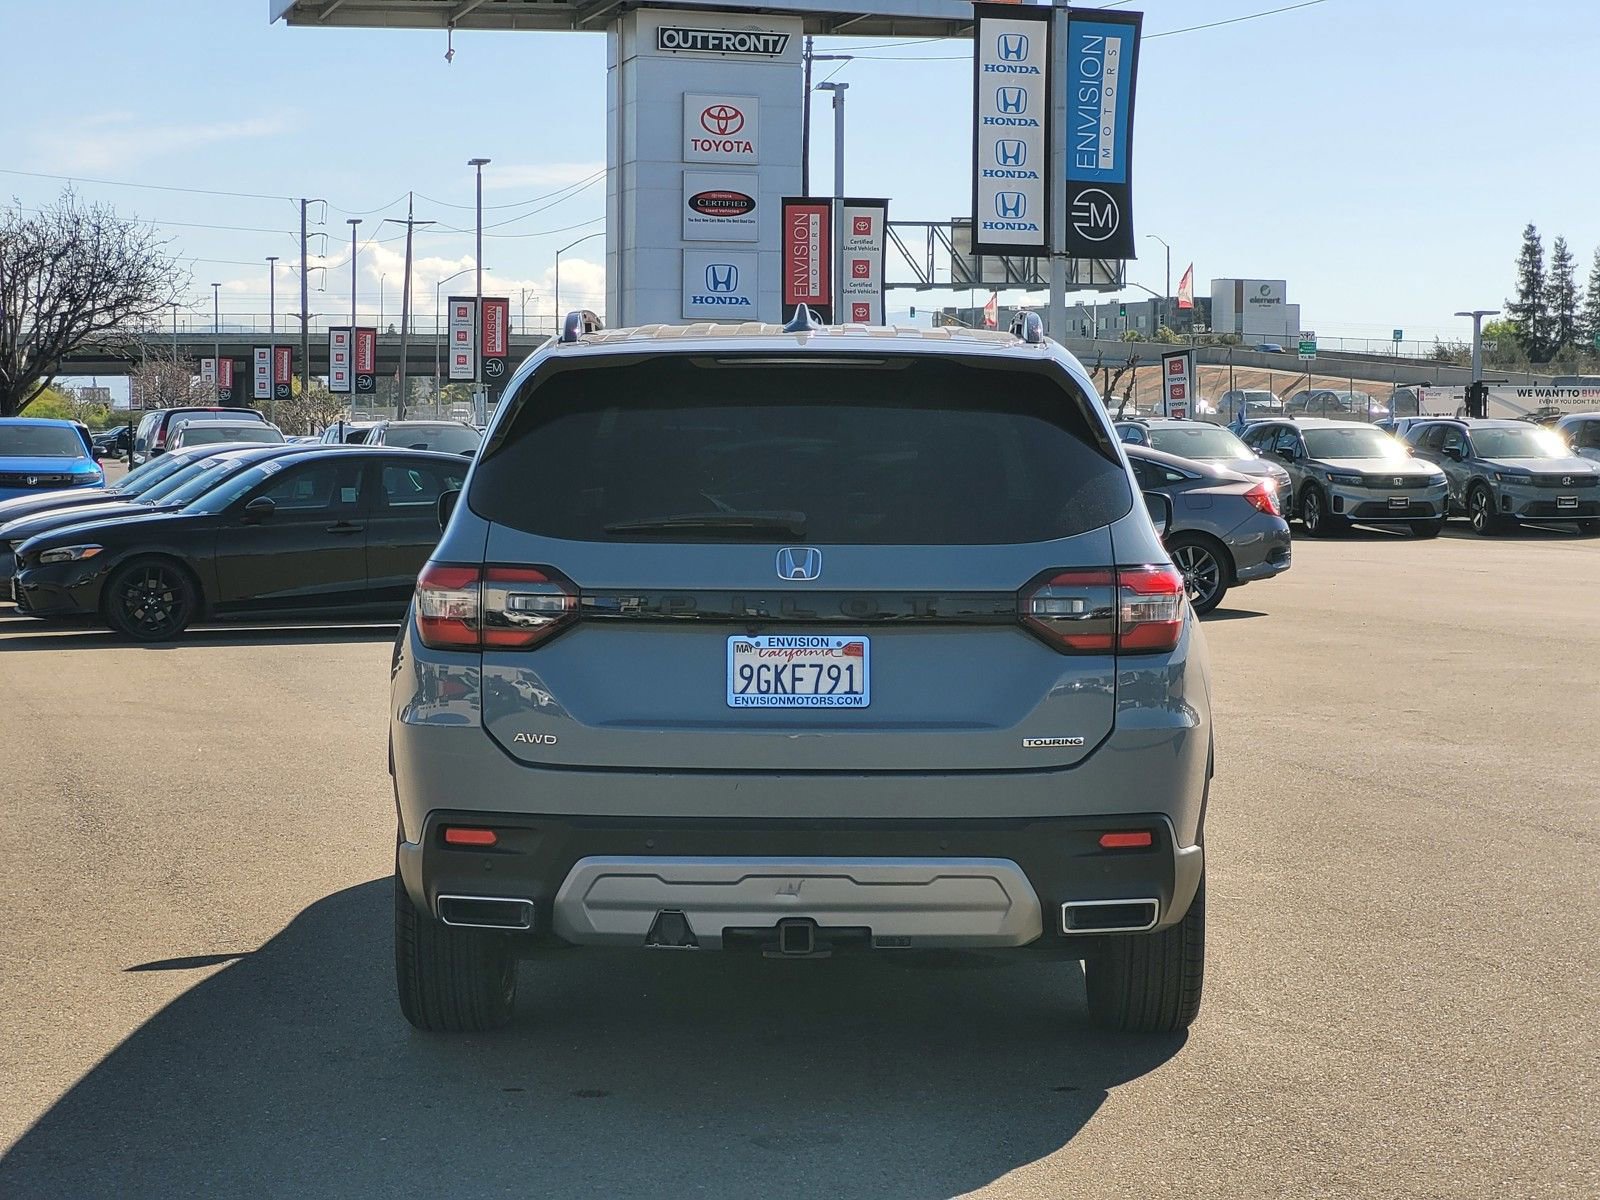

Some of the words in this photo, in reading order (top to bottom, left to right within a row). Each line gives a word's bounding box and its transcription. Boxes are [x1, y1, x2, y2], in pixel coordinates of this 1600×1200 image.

[983, 64, 1041, 75] HONDA
[1076, 34, 1103, 169] ENVISION
[1102, 49, 1117, 158] MOTORS
[983, 117, 1040, 127] HONDA
[691, 138, 754, 153] TOYOTA
[982, 169, 1039, 179] HONDA
[982, 221, 1039, 231] HONDA
[794, 213, 808, 297] ENVISION
[691, 295, 752, 306] HONDA
[487, 305, 496, 353] ENVISION
[358, 333, 366, 371] ENVISION
[1517, 389, 1533, 398] WE
[1535, 389, 1565, 398] WANT
[1566, 389, 1580, 398] TO
[1582, 389, 1600, 398] BUY
[768, 637, 829, 647] ENVISION
[736, 644, 753, 654] MAY
[758, 647, 843, 662] California
[739, 664, 859, 694] 9GKF791
[734, 696, 863, 705] ENVISIONMOTORS.COM
[513, 733, 557, 745] AWD
[1026, 738, 1083, 746] TOURING
